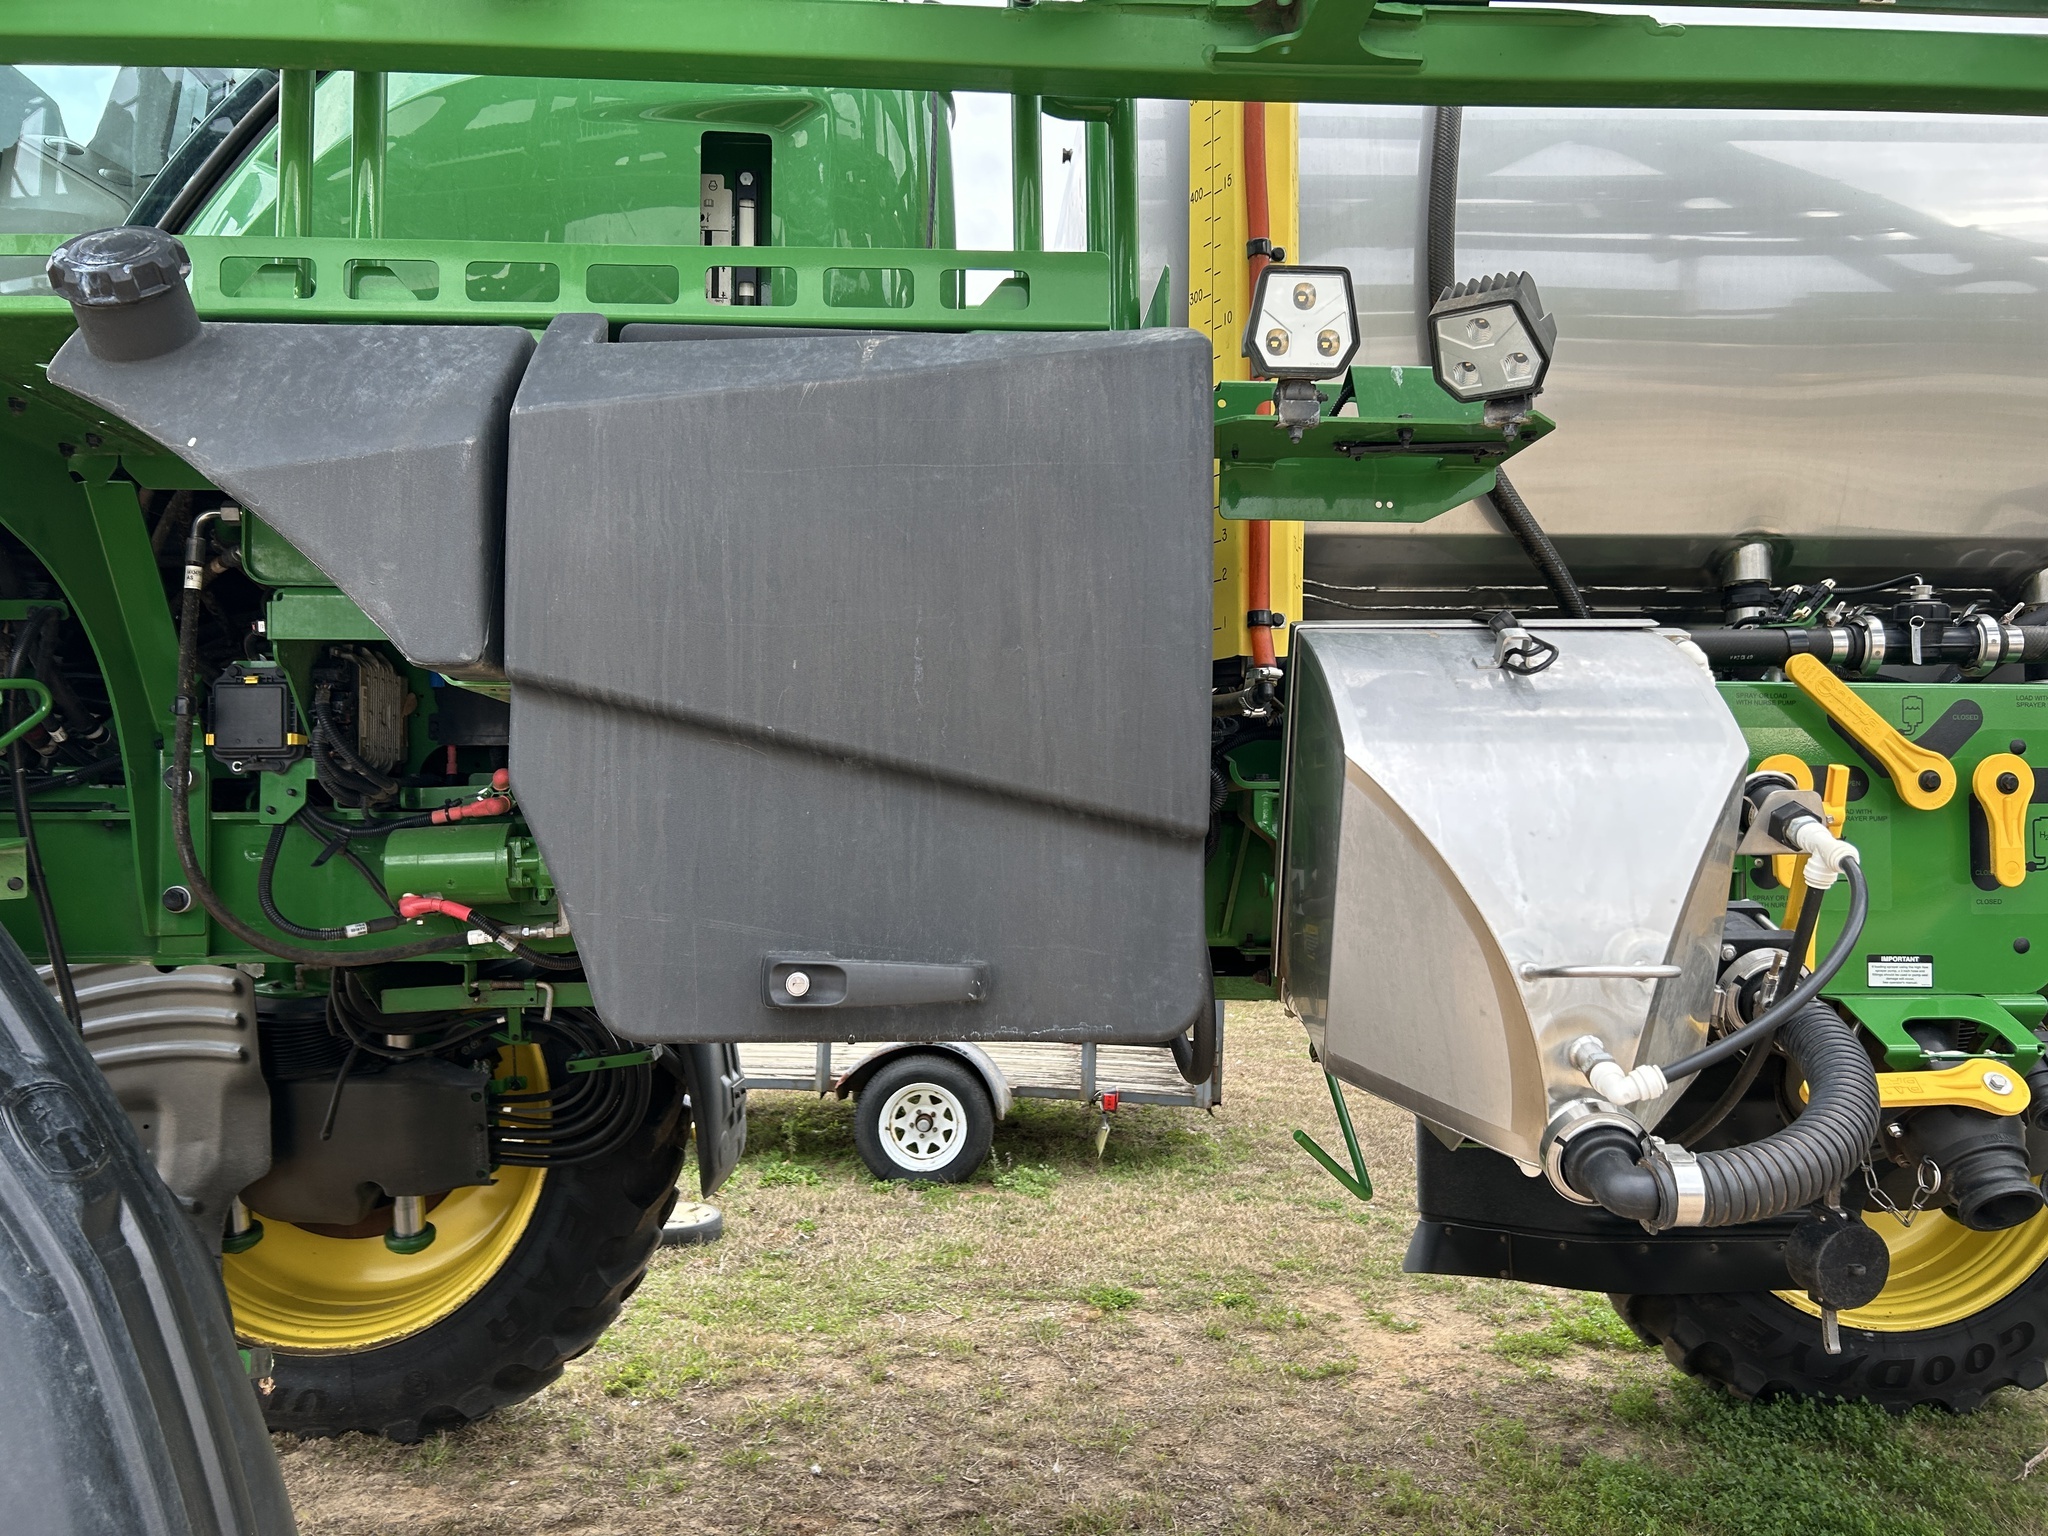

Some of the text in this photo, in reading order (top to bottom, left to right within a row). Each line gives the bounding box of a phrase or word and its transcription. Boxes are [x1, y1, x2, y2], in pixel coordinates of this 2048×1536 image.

[1222, 173, 1232, 188] 15
[1190, 186, 1204, 204] 400
[1188, 288, 1204, 306] 300
[1222, 310, 1233, 326] 10
[1221, 528, 1228, 542] 3
[1221, 567, 1228, 581] 2
